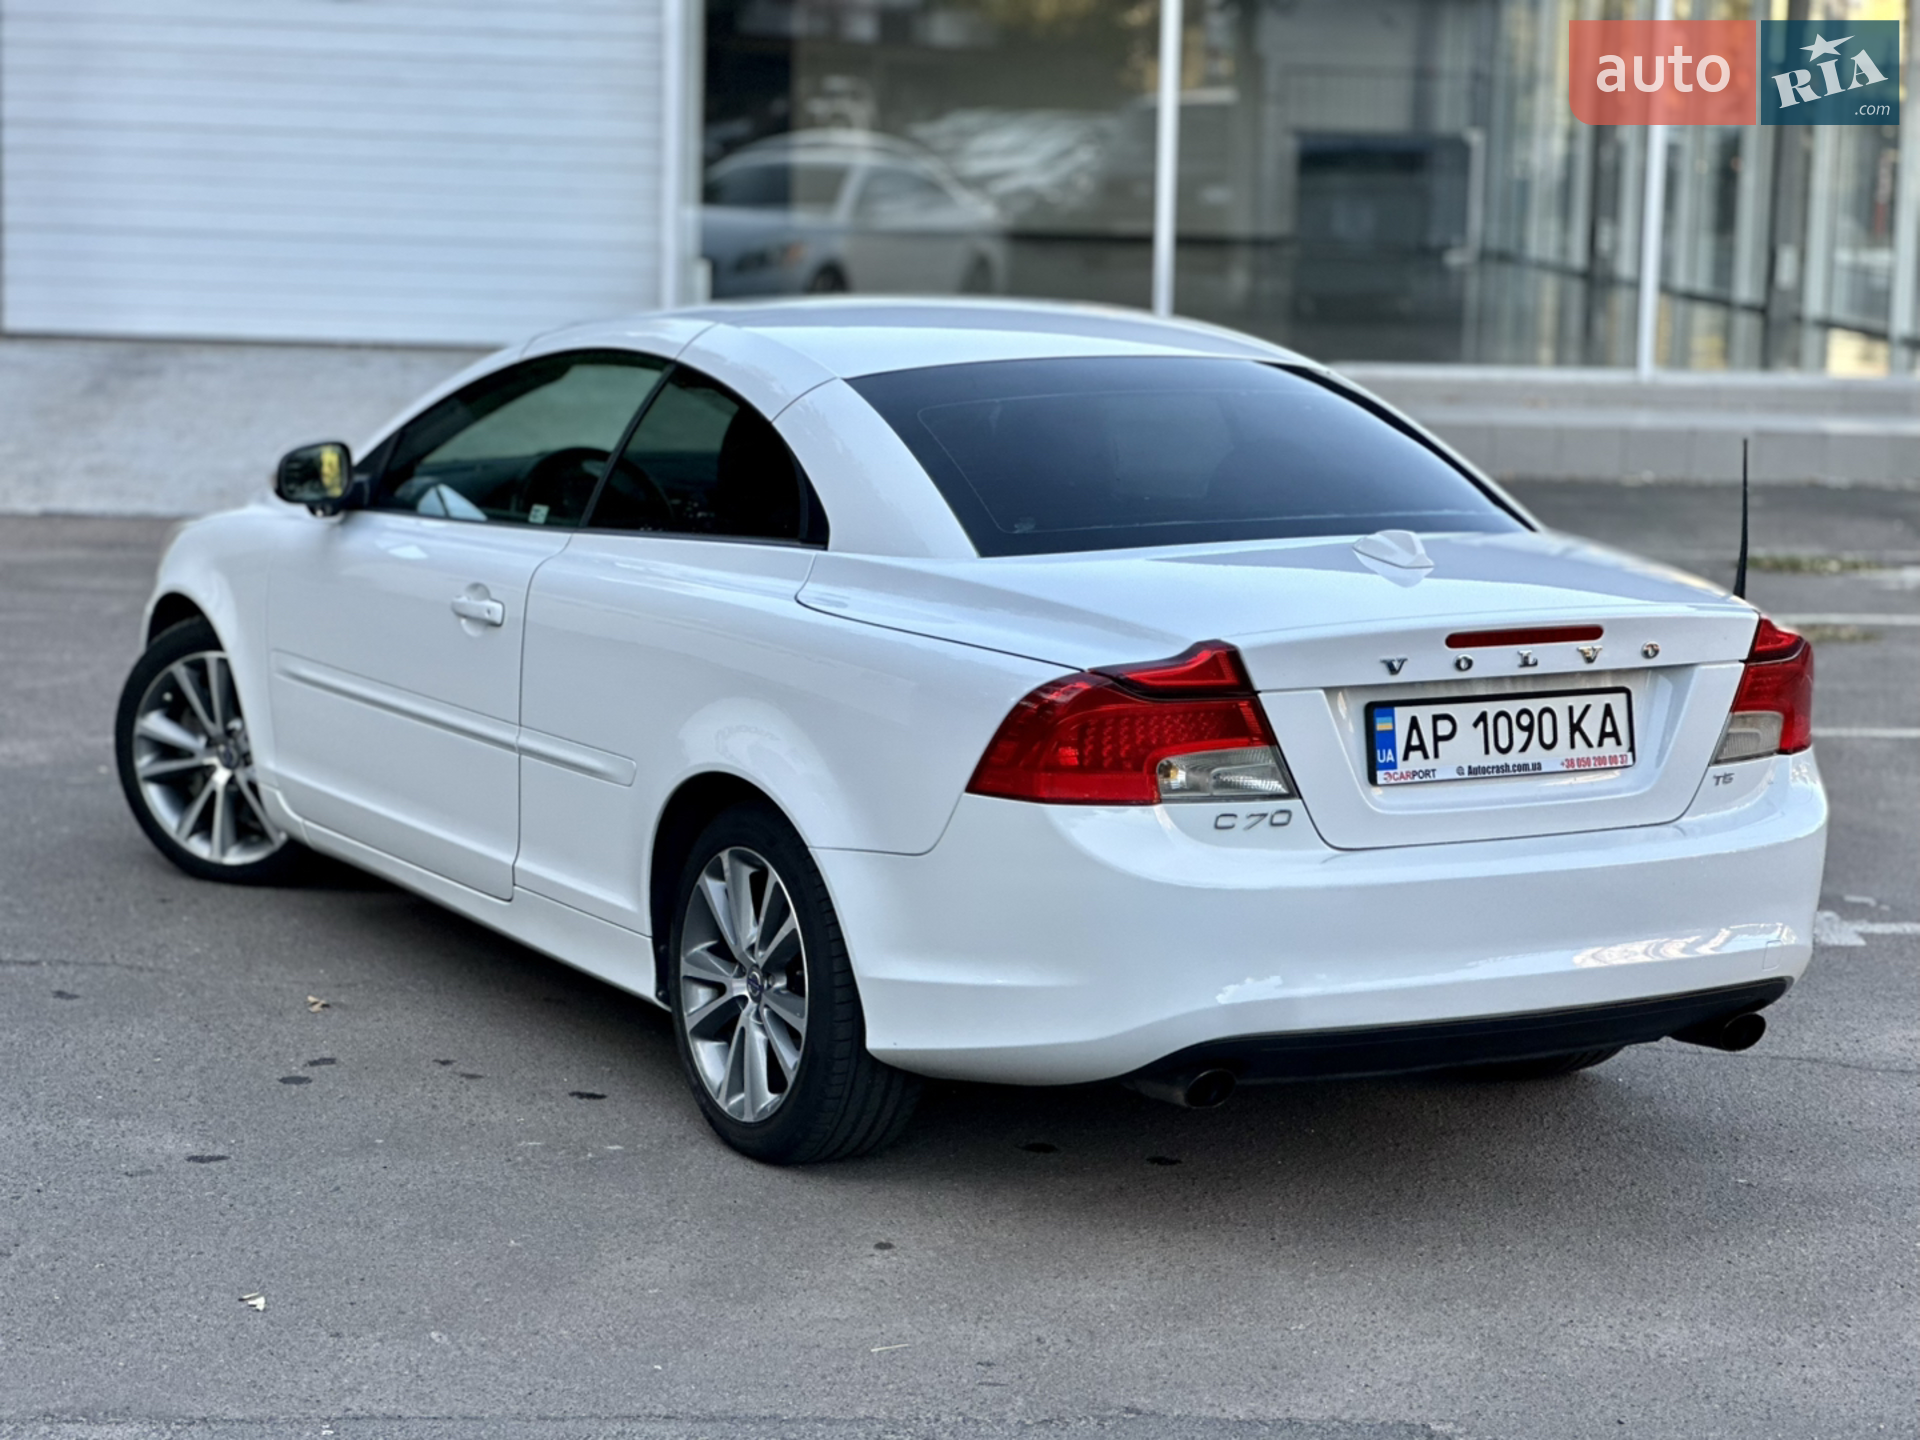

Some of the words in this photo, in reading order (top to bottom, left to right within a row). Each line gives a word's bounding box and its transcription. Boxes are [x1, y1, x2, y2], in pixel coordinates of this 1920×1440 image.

[1380, 640, 1661, 676] VOLVO
[1402, 713, 1458, 762] AP
[1472, 706, 1559, 756] 1090
[1568, 702, 1623, 750] KA
[1376, 748, 1396, 763] UA
[1392, 768, 1437, 782] CARPORT
[1467, 761, 1543, 776] Autocrash.com.ua
